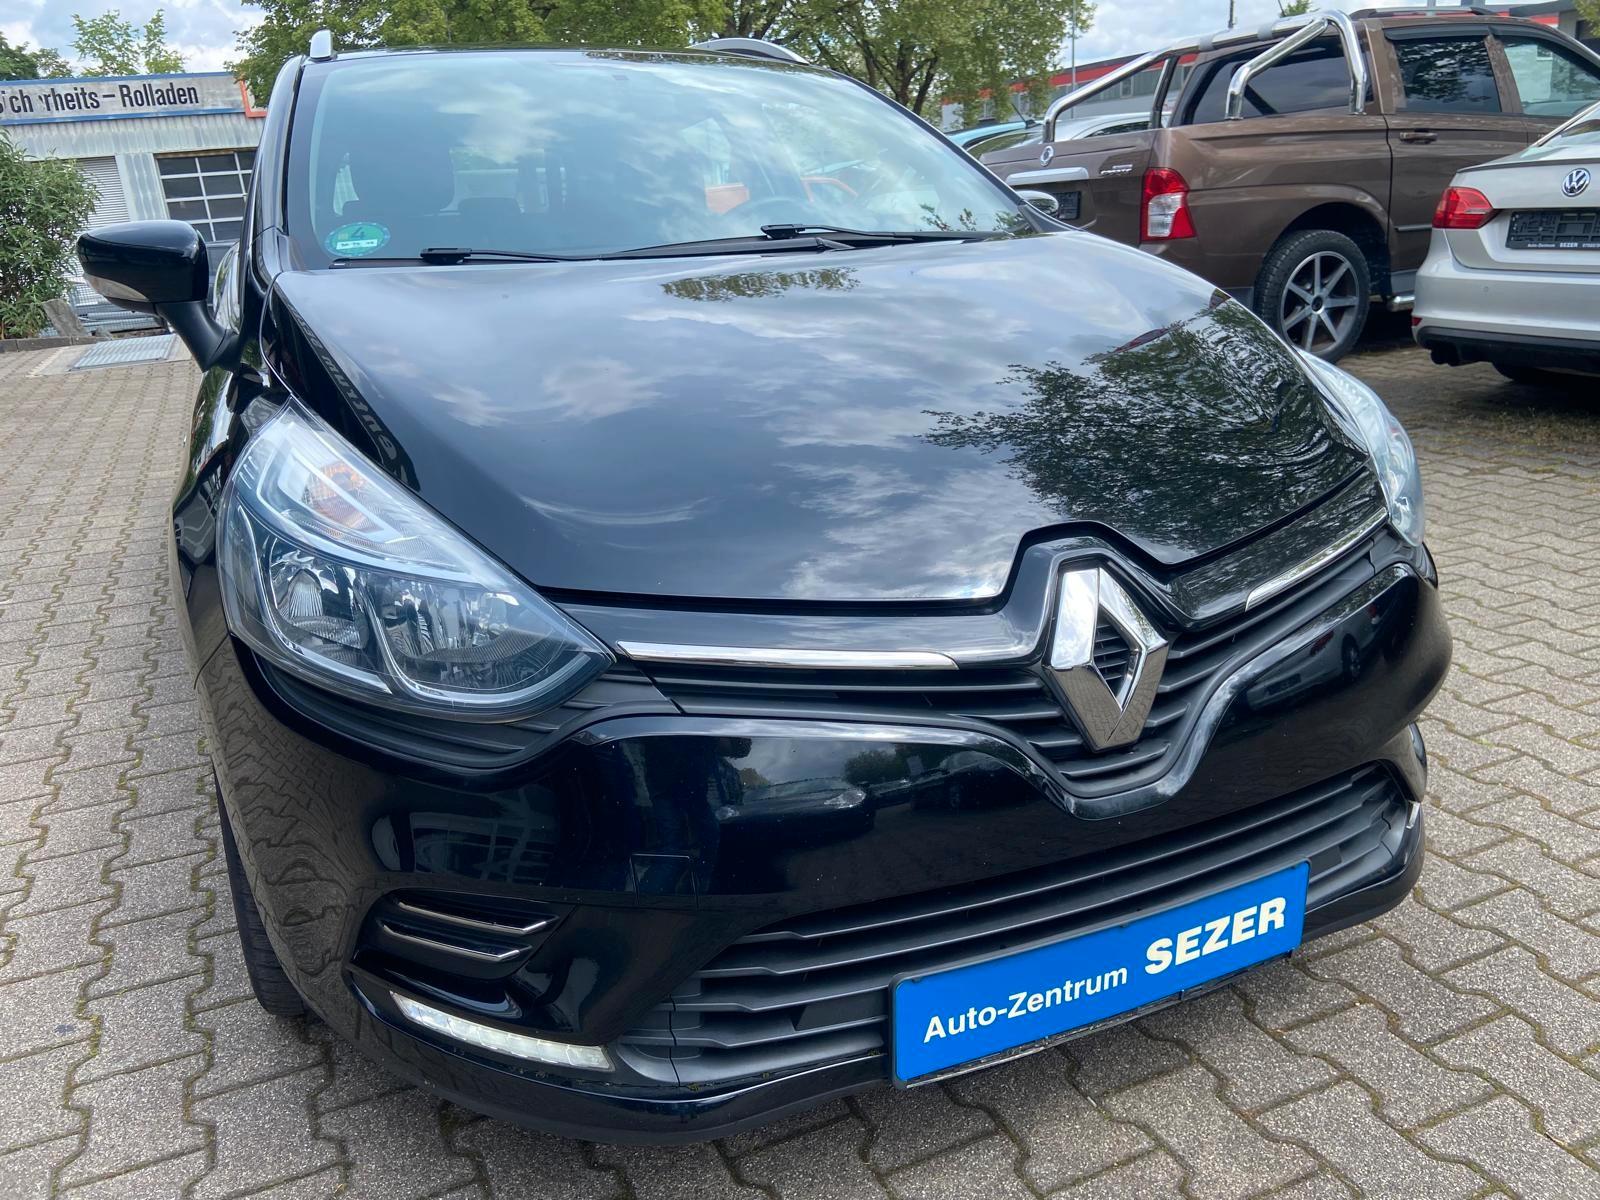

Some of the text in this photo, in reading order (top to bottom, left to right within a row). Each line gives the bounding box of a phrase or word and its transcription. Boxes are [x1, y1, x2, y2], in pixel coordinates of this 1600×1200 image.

[118, 82, 199, 108] Rolladen
[923, 896, 1287, 1043] Auto-Zentrum SEZER
